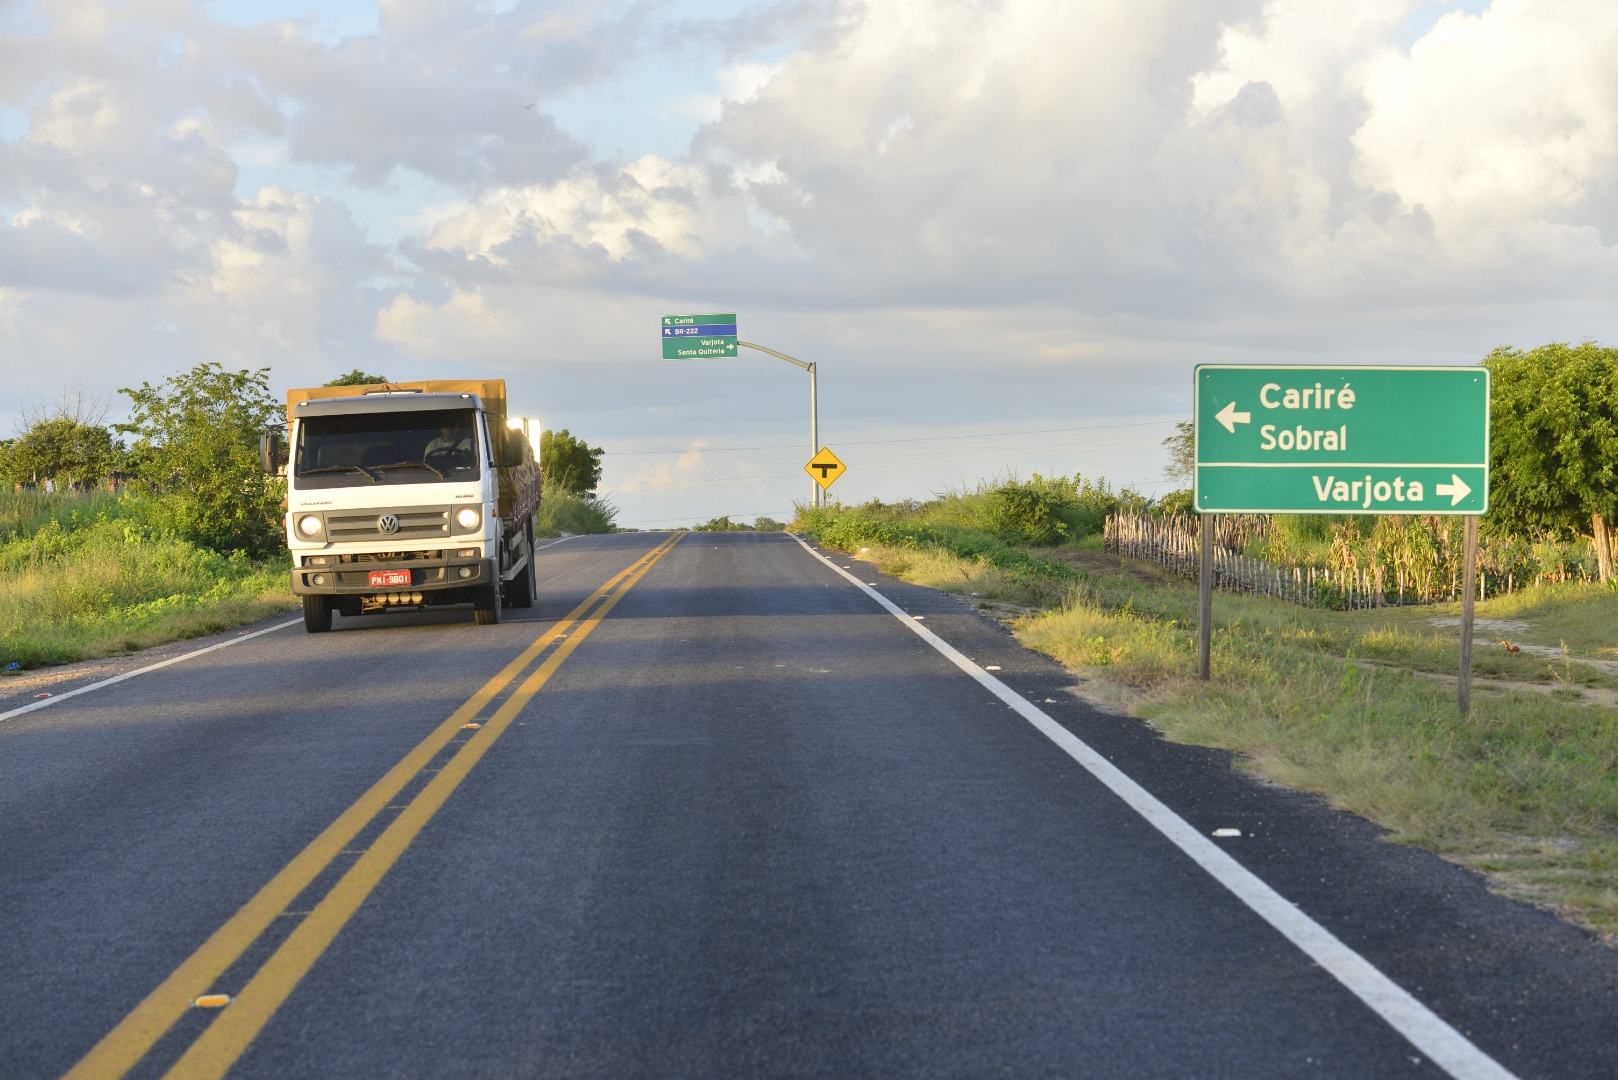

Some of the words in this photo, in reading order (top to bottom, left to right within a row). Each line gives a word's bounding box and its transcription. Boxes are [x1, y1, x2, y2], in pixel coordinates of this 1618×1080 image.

[1259, 382, 1356, 409] Cariré
[1260, 424, 1347, 450] Sobral
[1311, 475, 1424, 509] Varjota
